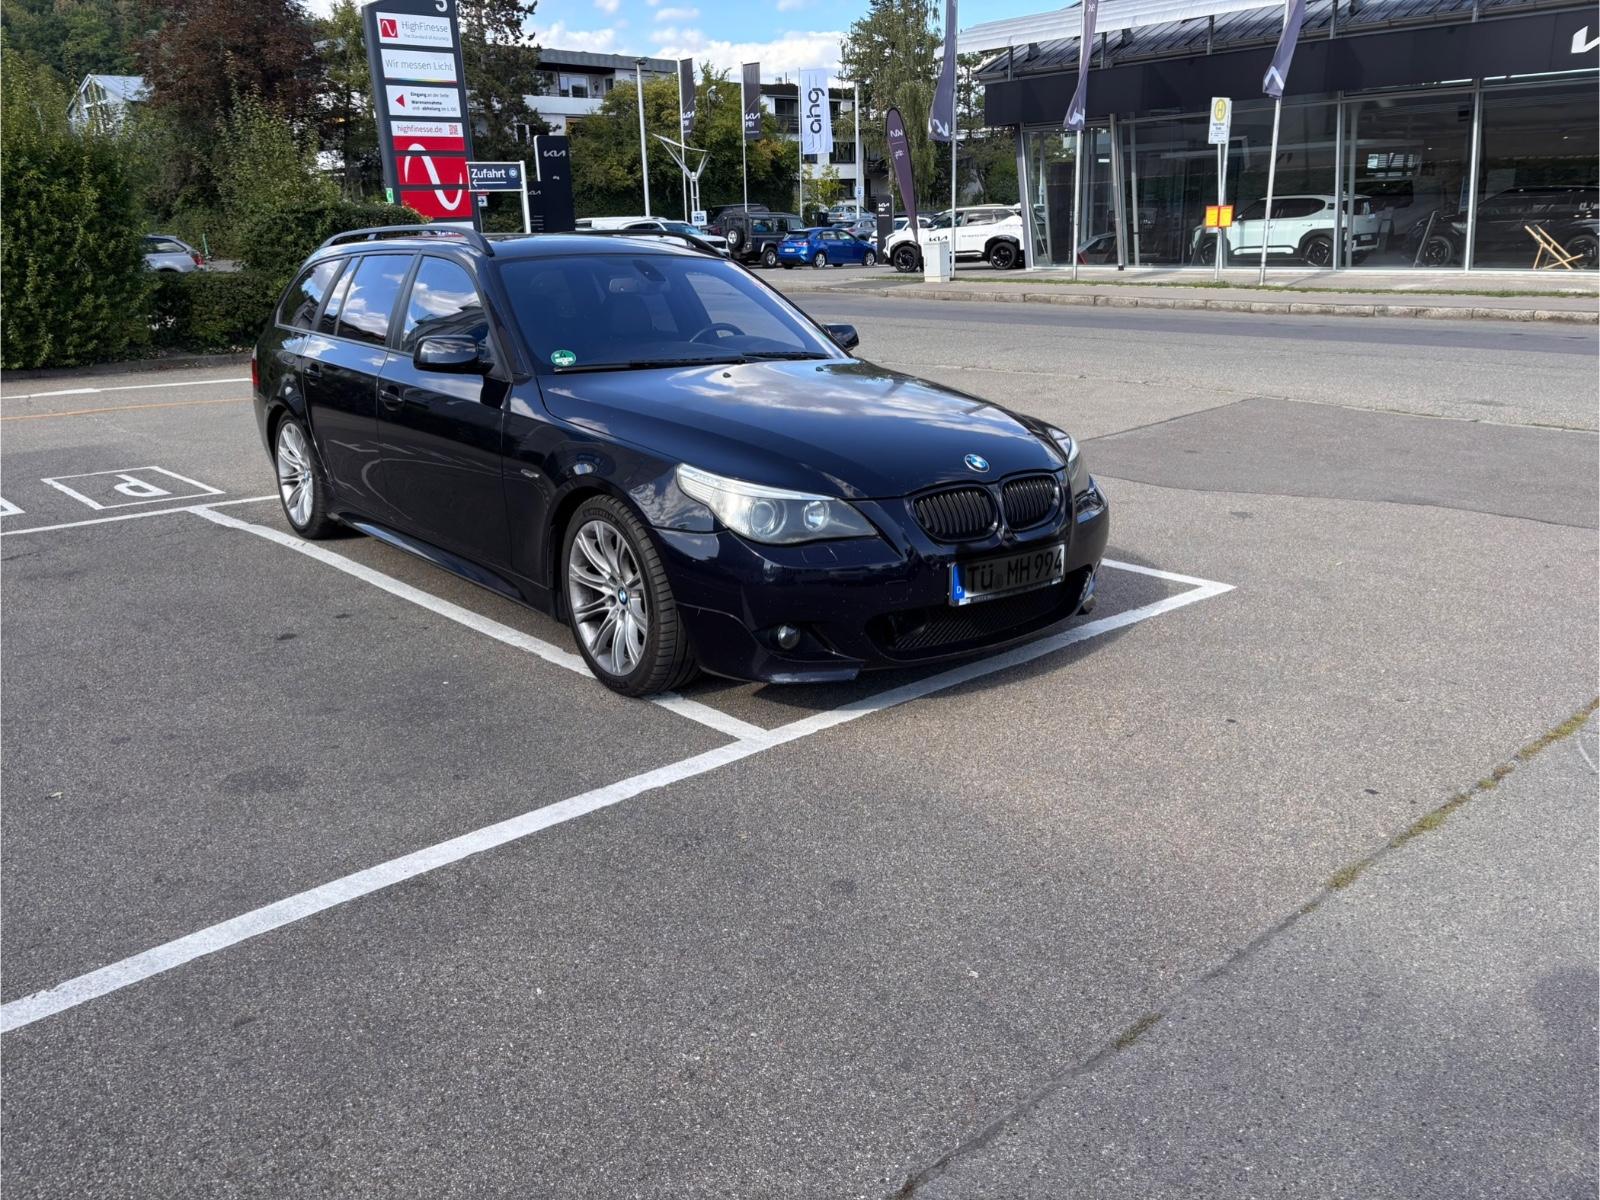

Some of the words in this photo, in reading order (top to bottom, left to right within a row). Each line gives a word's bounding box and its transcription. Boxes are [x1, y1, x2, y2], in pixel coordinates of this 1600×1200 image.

[402, 21, 448, 33] HighFinesse
[385, 59, 399, 68] Wir
[401, 61, 432, 70] messen
[433, 61, 453, 71] Licht
[806, 87, 825, 134] ahg
[397, 124, 443, 134] highfinesse.de
[470, 168, 506, 178] Zufahrt
[114, 474, 173, 497] P
[966, 563, 994, 593] TÜ
[956, 585, 962, 594] D
